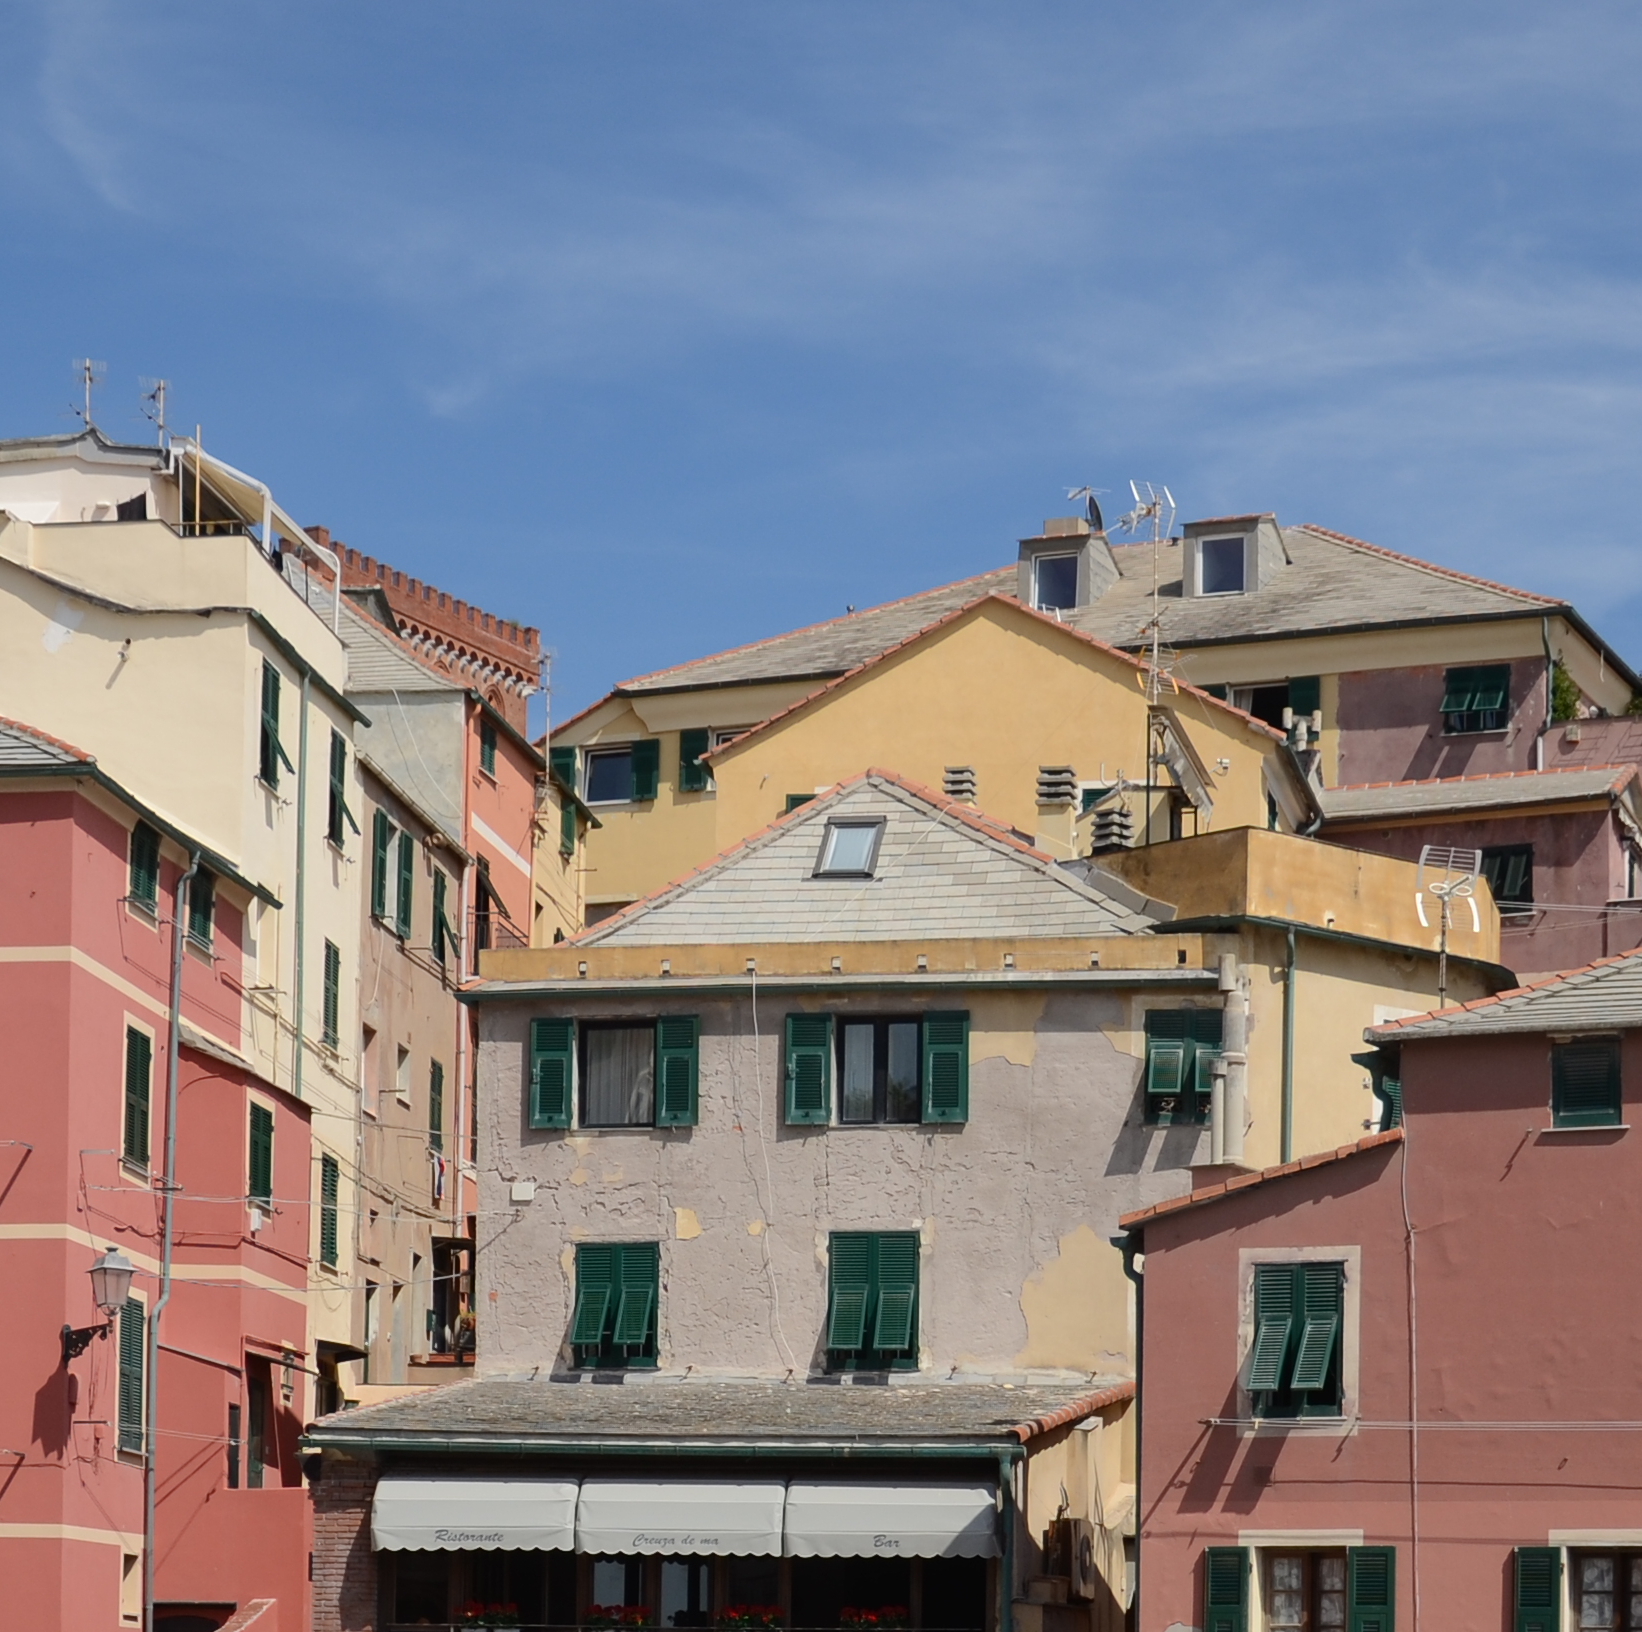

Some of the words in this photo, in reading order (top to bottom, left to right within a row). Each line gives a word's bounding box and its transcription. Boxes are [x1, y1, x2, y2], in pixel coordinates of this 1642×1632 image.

[434, 1529, 504, 1543] Ristorante
[632, 1533, 675, 1548] Creuza
[681, 1535, 695, 1547] de
[700, 1537, 719, 1547] ma
[873, 1534, 900, 1549] Bar
